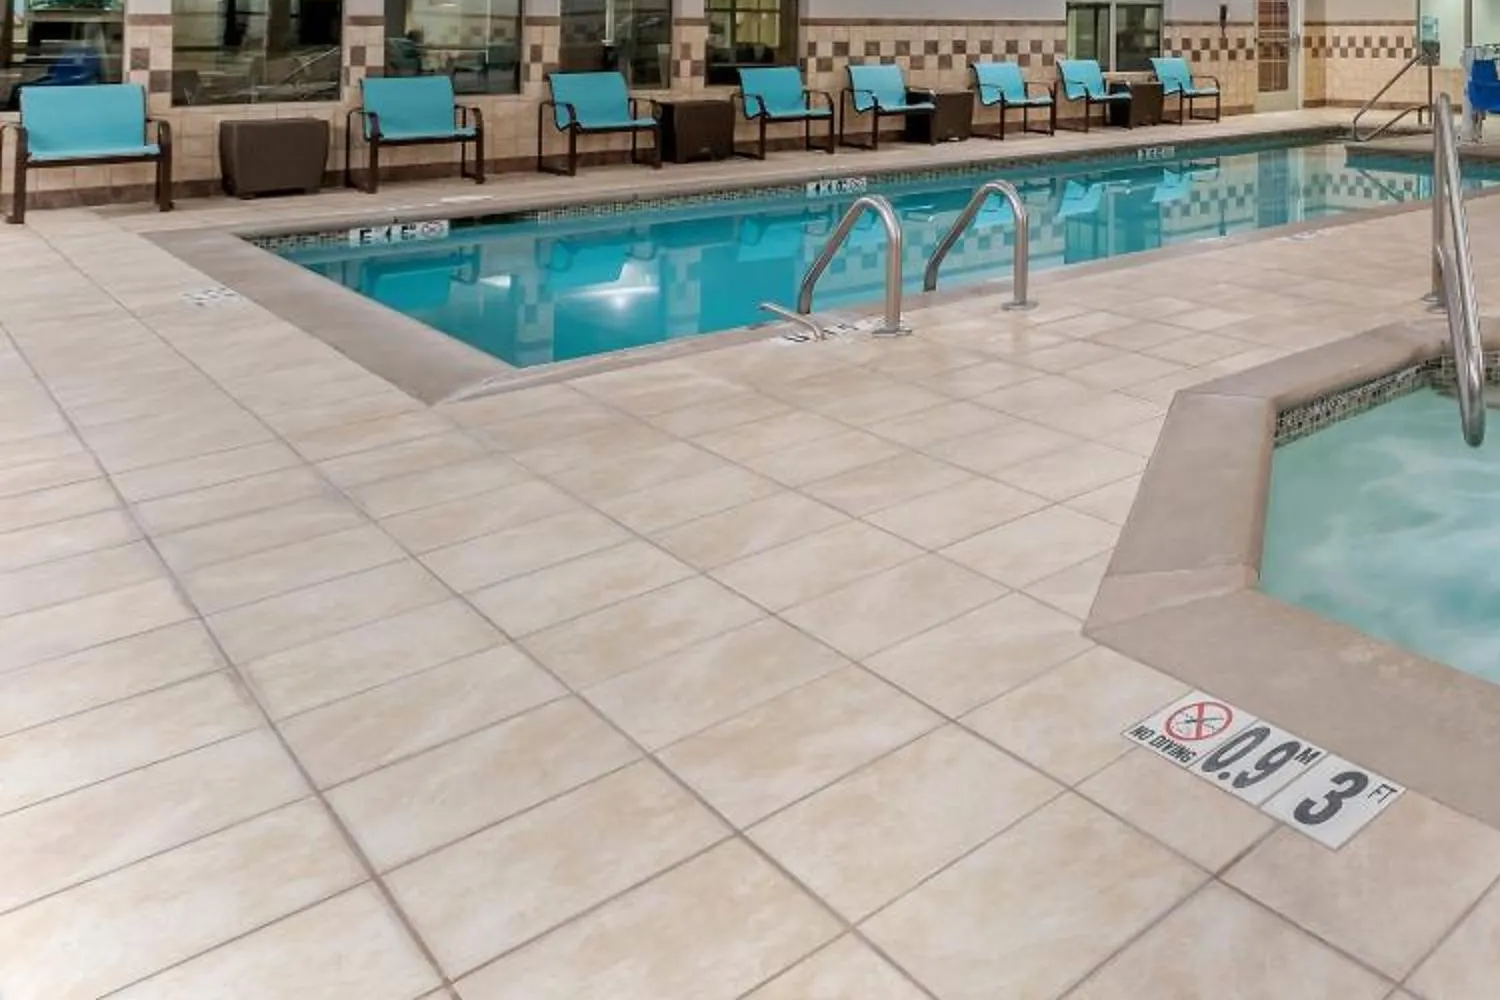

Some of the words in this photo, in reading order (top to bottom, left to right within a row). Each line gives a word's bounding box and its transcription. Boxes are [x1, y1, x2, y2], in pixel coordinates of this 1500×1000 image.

[1130, 725, 1155, 742] NO
[1150, 734, 1197, 763] DIVING
[1201, 727, 1302, 789] 0.9
[1294, 747, 1321, 766] M
[1293, 771, 1368, 825] 3
[1367, 783, 1398, 804] FT
